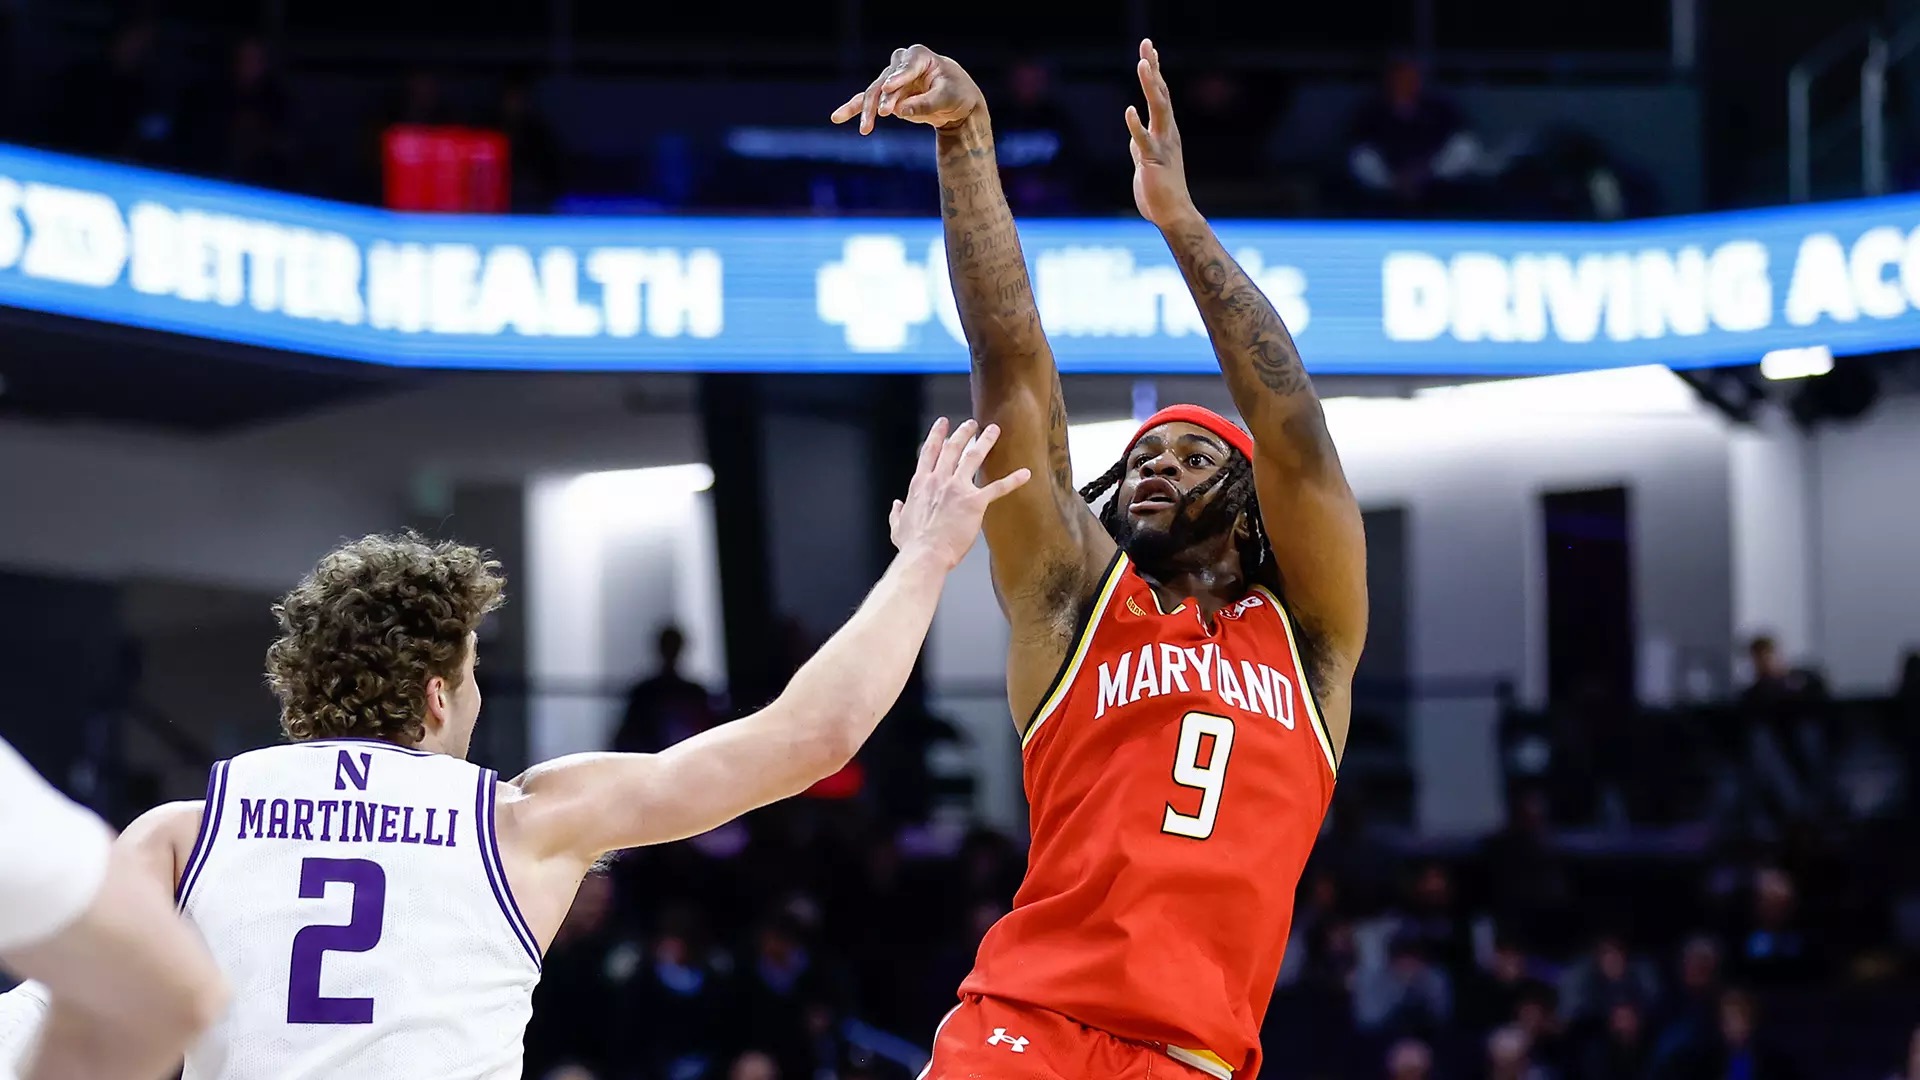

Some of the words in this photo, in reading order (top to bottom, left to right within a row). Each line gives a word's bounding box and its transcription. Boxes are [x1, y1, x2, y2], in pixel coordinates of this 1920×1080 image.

[130, 202, 365, 325] BETTER
[368, 243, 724, 338] HEALTH
[1382, 241, 1772, 342] DRIVING
[237, 798, 459, 847] MARTINELLI
[334, 750, 372, 791] N
[1160, 710, 1235, 840] 9
[287, 857, 386, 1024] 2
